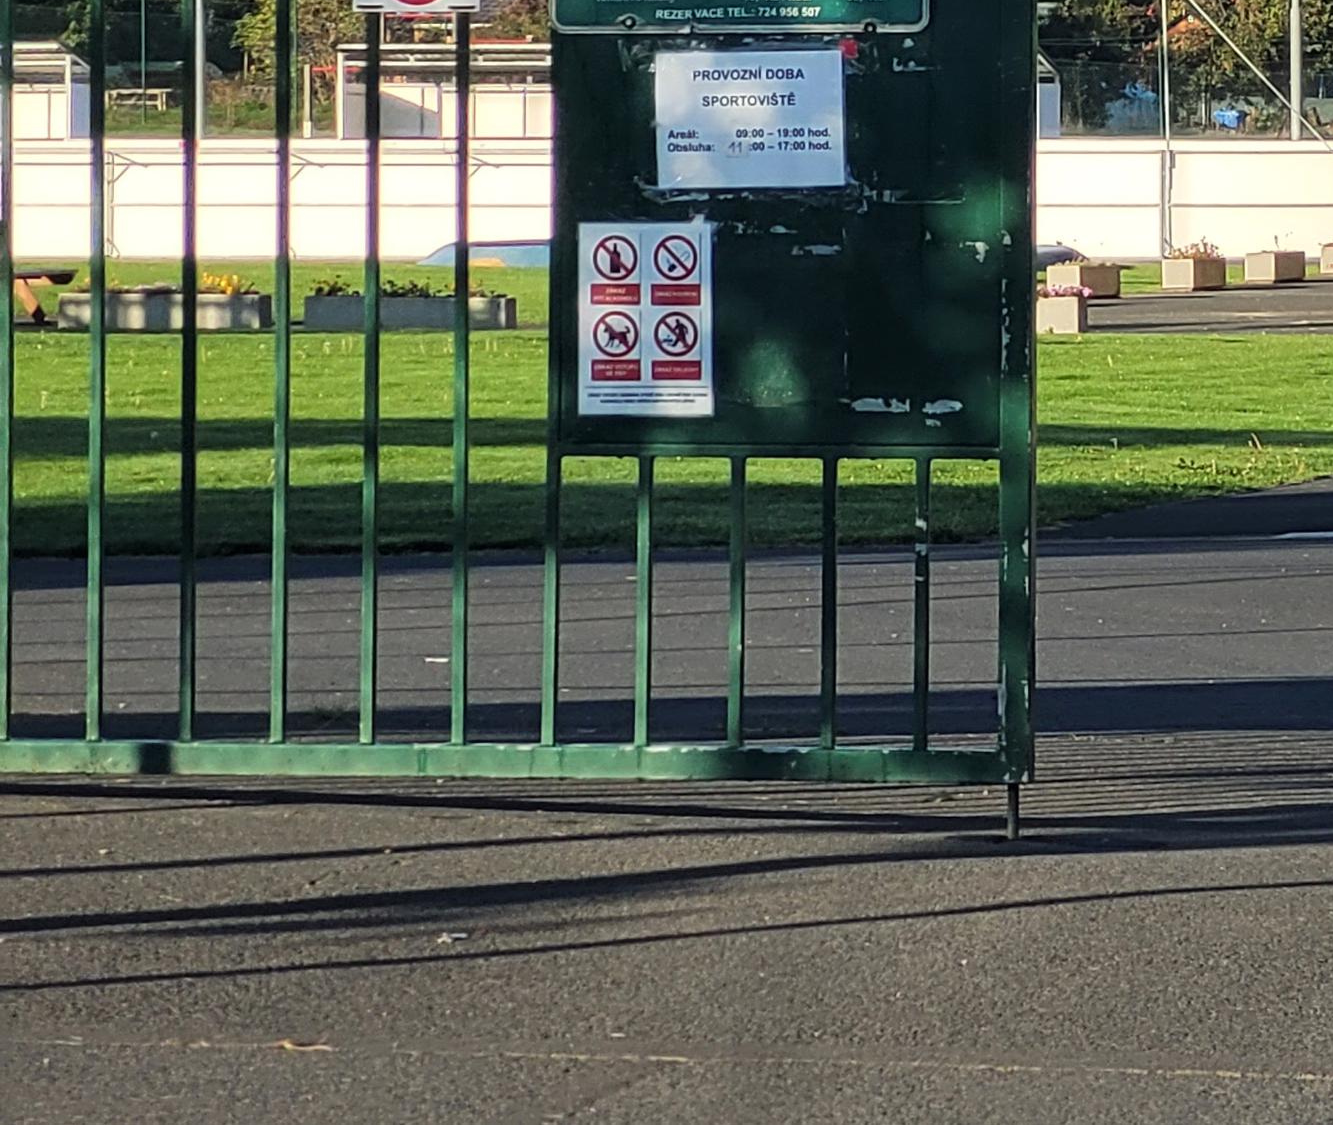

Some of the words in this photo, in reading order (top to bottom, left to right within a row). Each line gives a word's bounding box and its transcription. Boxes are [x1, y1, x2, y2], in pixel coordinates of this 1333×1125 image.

[758, 7, 777, 16] 724
[693, 66, 762, 81] PROVOZNÍ
[765, 68, 805, 80] DOBA
[702, 92, 796, 107] SPORTOVIŠTĚ
[668, 129, 699, 140] Areál:
[736, 128, 764, 139] 09:00
[777, 128, 805, 138] 19:00
[808, 127, 831, 138] hod.
[668, 142, 715, 153] Obsluha:
[777, 141, 805, 151] 17:00
[808, 140, 832, 151] hod.
